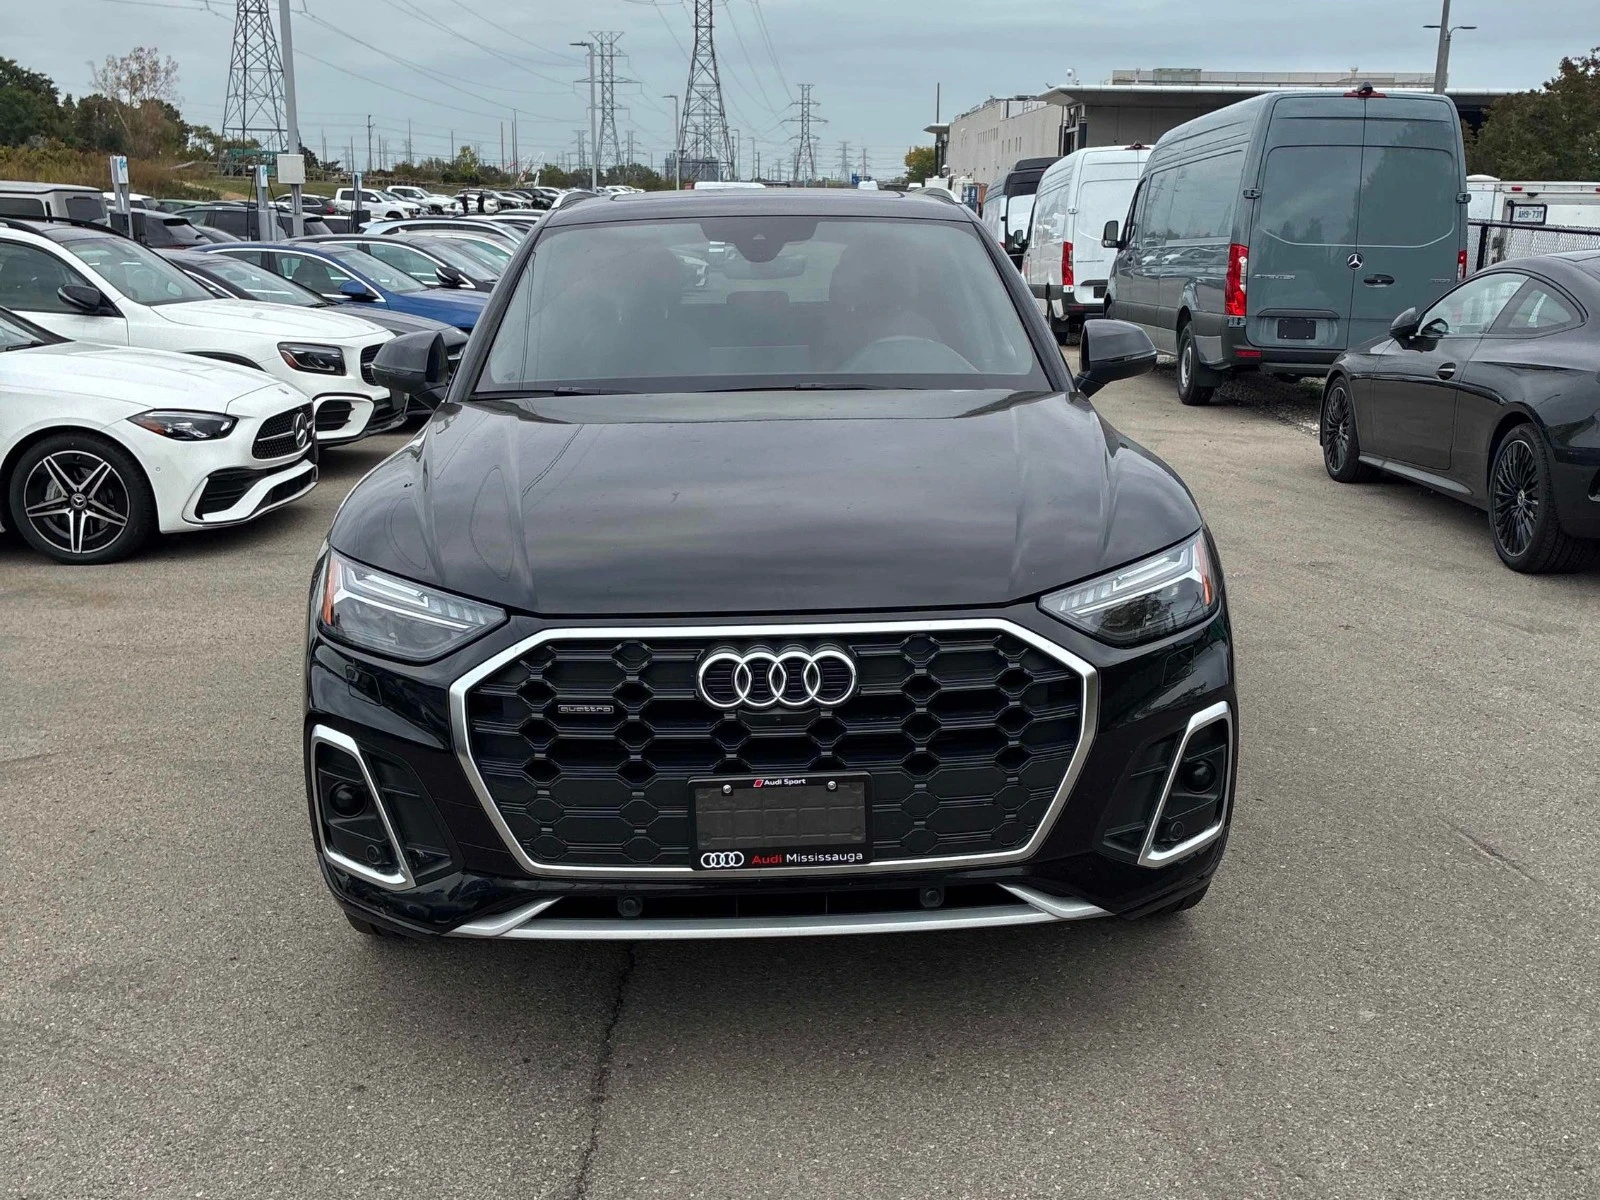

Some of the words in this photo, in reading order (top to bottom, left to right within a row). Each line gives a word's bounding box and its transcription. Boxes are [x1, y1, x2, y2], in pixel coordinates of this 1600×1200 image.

[783, 778, 806, 786] Sport
[751, 854, 783, 864] Audi
[786, 851, 864, 863] Mississauga
